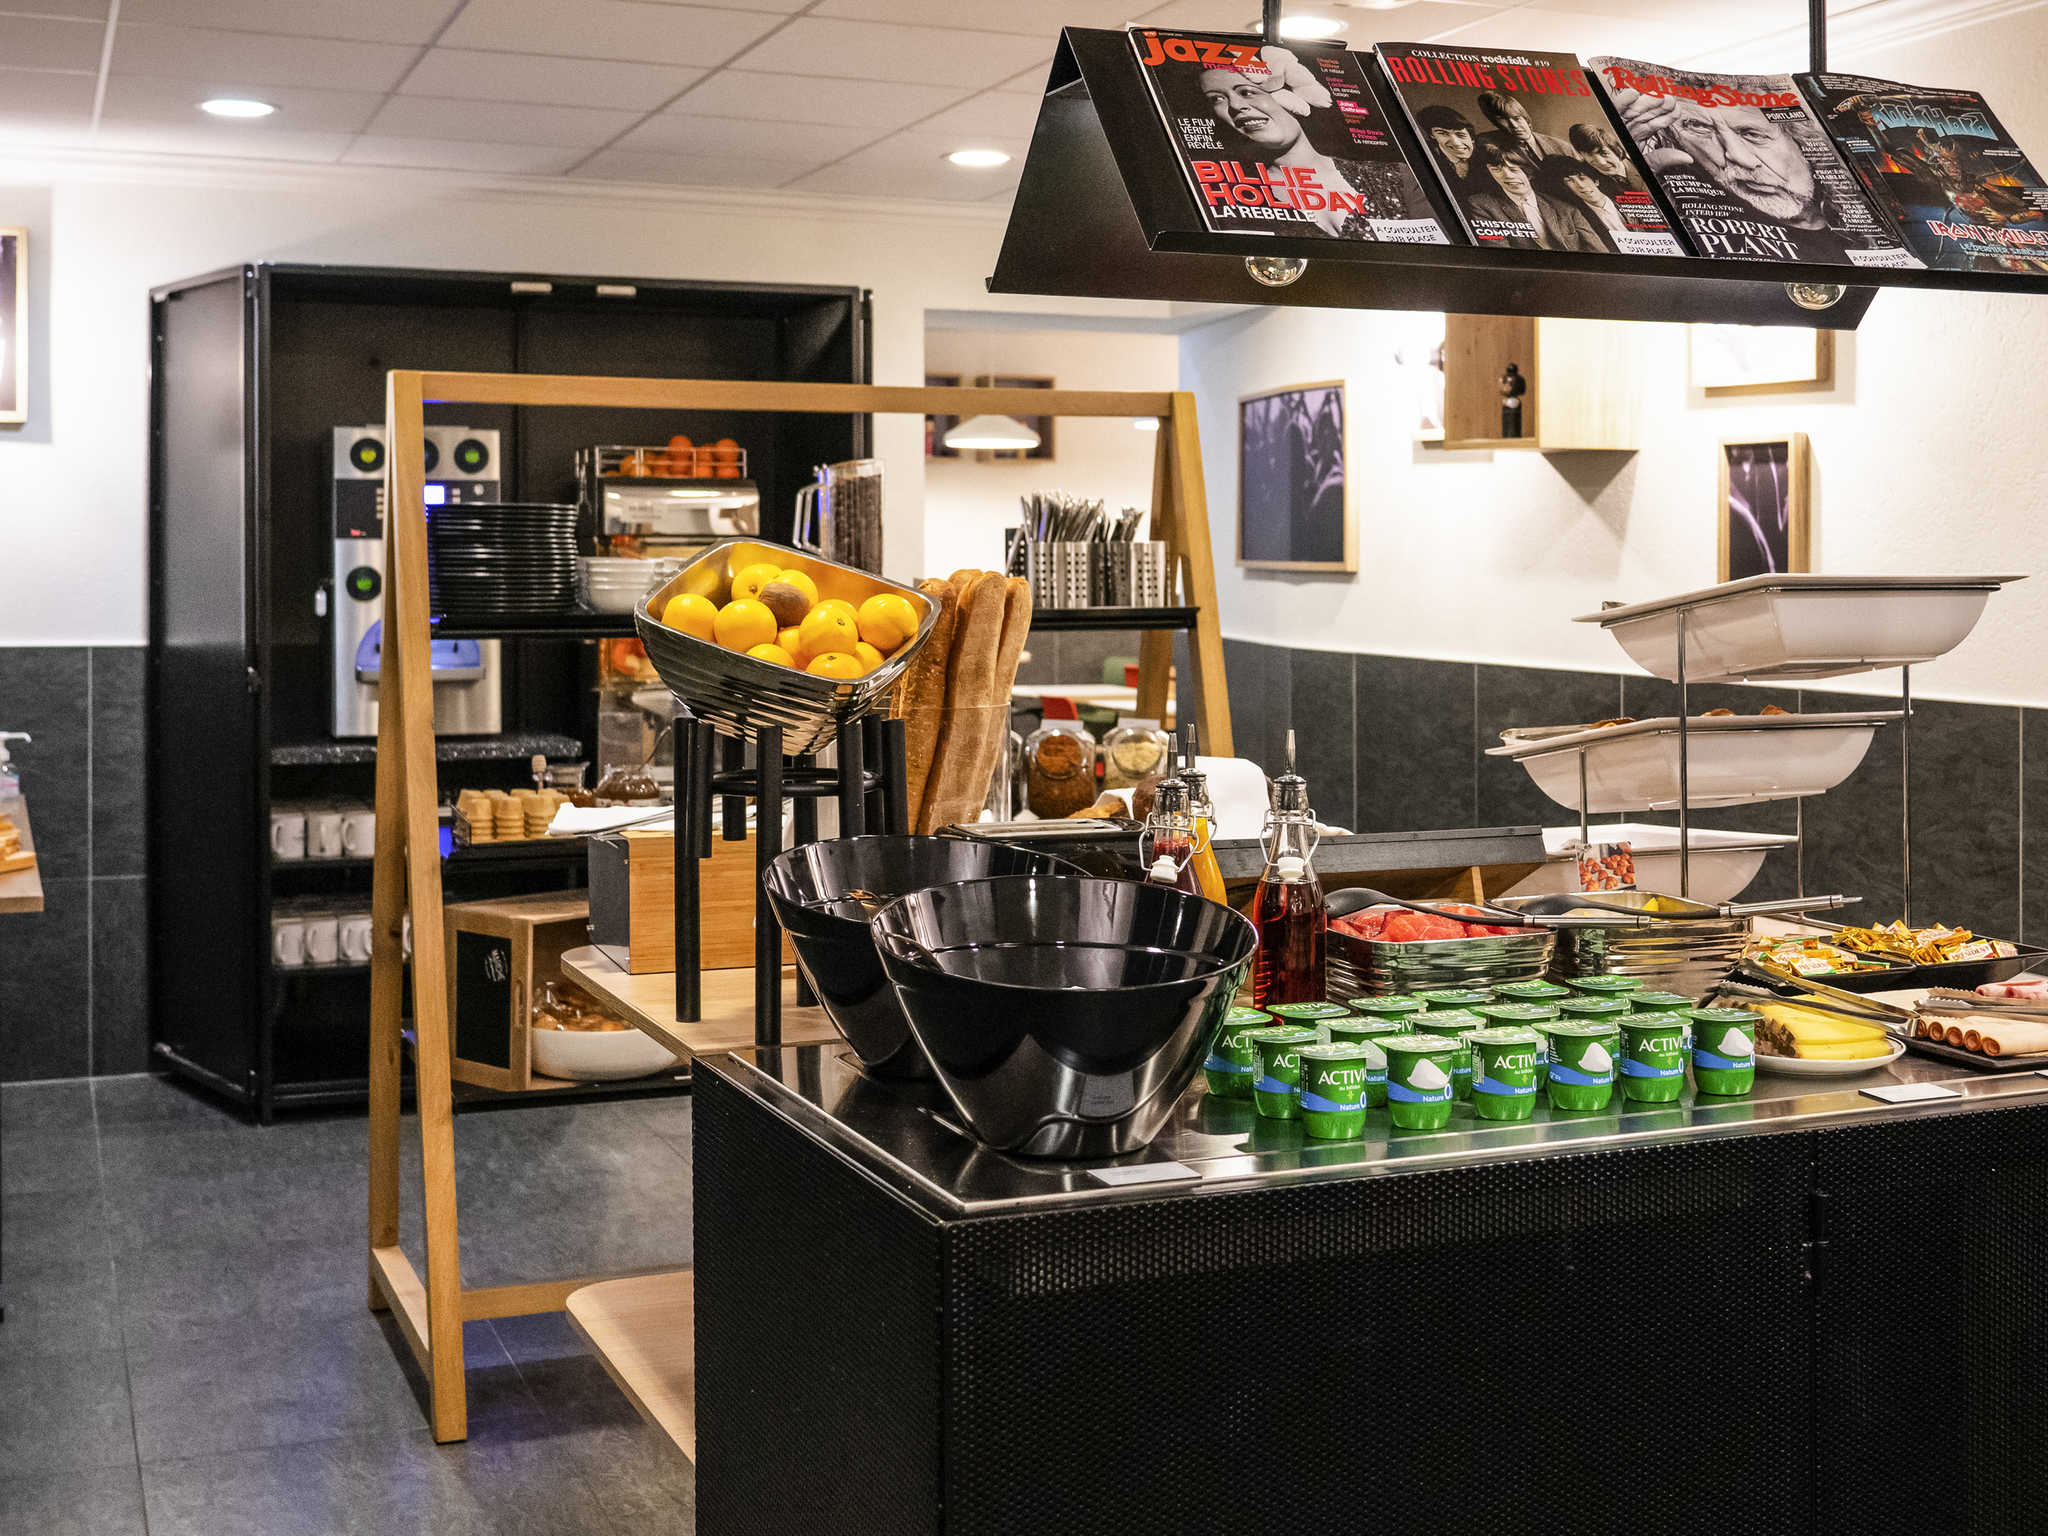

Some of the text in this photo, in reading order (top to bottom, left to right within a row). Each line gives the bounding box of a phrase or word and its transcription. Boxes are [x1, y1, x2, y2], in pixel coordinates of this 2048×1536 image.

[1142, 31, 1267, 66] jazz
[1411, 50, 1480, 62] COLLECTION
[1203, 62, 1272, 75] magazine
[1387, 57, 1591, 97] ROLLING STONES
[1602, 66, 1718, 107] Rolling
[1709, 85, 1801, 107] Stone
[1766, 111, 1806, 121] PORTLAND
[1178, 118, 1215, 127] LE FILM
[1184, 134, 1213, 142] ENFIN
[1191, 160, 1324, 190] BILLIE
[1200, 182, 1368, 215] HOLIDAY
[1682, 202, 1717, 211] ROLLING
[1210, 205, 1319, 223] LA REBELLE
[1685, 209, 1730, 217] INTERVIEW
[1471, 219, 1534, 231] L'HISTOIRE
[1689, 218, 1789, 241] ROBERT
[1476, 228, 1539, 239] COMPLÈTE
[1926, 220, 1986, 243] IRON
[1699, 234, 1801, 260] PLANT
[1733, 1061, 1751, 1069] Nature
[1660, 1069, 1679, 1077] Nature
[1592, 1076, 1610, 1084] Nature
[1339, 1103, 1360, 1111] Nature
